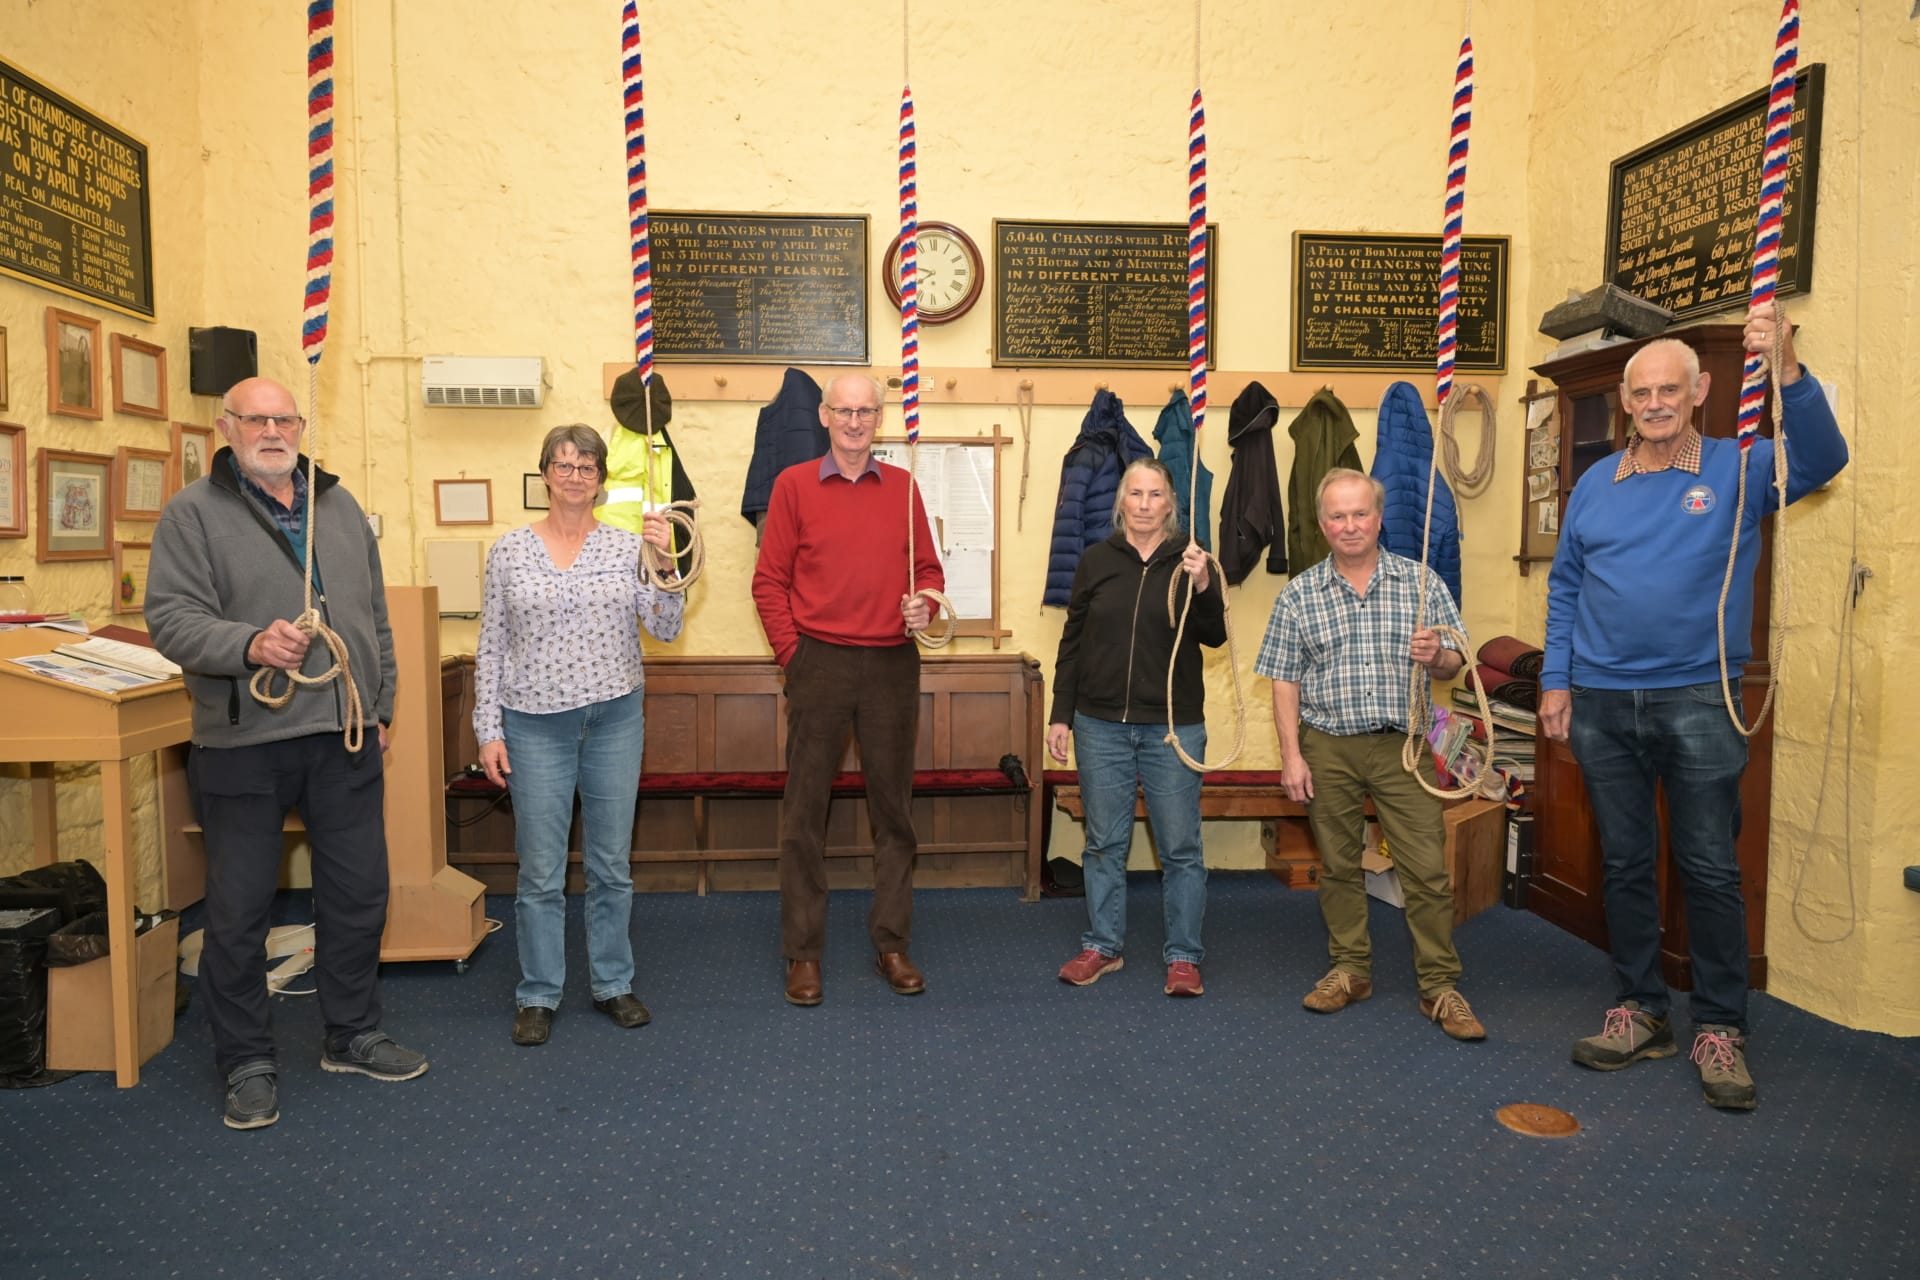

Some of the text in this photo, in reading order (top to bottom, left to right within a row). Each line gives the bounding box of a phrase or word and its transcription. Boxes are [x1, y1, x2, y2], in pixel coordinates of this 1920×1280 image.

[13, 86, 26, 108] OF
[30, 96, 87, 142] GRANDSIRE
[53, 129, 66, 149] OF
[100, 155, 141, 188] CHANGES
[1624, 172, 1636, 186] ON
[1640, 164, 1654, 179] THE
[1678, 144, 1695, 163] DAY
[1698, 138, 1710, 153] OF
[1714, 114, 1763, 147] FEBRUARY
[31, 136, 126, 200] RUNG IN 3 HOURS
[1623, 141, 1762, 208] TRIPLES WAS RUNG IN 3 HOURS
[1624, 134, 1747, 198] A PEAL OF CHANGES OF
[14, 152, 30, 176] ON
[48, 168, 79, 198] APRIL
[85, 184, 112, 212] 1999
[1622, 204, 1643, 220] MARK
[1648, 196, 1662, 210] THE
[1692, 155, 1758, 192] ANNIVERSARY
[3, 194, 23, 212] PLACE
[5, 173, 126, 238] PEAL ON AUGMENTED BELLS
[1621, 175, 1743, 231] CASTING OF THE BACK FIVE
[15, 212, 43, 232] WINTER
[1621, 226, 1642, 242] BELLS
[1646, 220, 1656, 233] BY
[1661, 203, 1701, 227] MEMBERS
[1706, 197, 1718, 210] OF
[1723, 188, 1741, 204] THE
[82, 228, 100, 243] JOHN
[697, 223, 766, 236] CHANGES
[770, 228, 804, 237] WERE
[811, 225, 854, 238] RUNG
[1052, 232, 1123, 244] CHANGES
[1125, 236, 1158, 245] WERE
[1162, 234, 1190, 246] RUN
[1620, 208, 1719, 253] SOCIETY & YORKSHIRE
[15, 238, 33, 254] DOVE
[654, 239, 670, 247] ON
[676, 239, 700, 247] THE
[732, 240, 756, 248] DAY
[762, 241, 776, 249] OF
[782, 242, 817, 250] APRIL
[1307, 246, 1316, 256] A
[1319, 246, 1347, 256] PEAL
[1387, 247, 1424, 258] MAJOR
[662, 251, 674, 259] IN
[690, 250, 732, 260] HOURS
[739, 252, 765, 261] AND
[1012, 258, 1024, 266] IN
[1038, 256, 1079, 267] HOURS
[1084, 260, 1110, 268] AND
[1112, 249, 1174, 258] NOVEMBER
[657, 264, 670, 273] IN
[676, 264, 683, 273] 7
[688, 264, 768, 274] DIFFERENT
[823, 267, 849, 276] VIZ.
[1351, 258, 1421, 270] CHANGES
[83, 264, 127, 288] DAVID TOWN
[83, 275, 114, 294] DOUGLAS
[1008, 270, 1189, 283] IN 7 DIFFERENT PEALS. VI
[1310, 271, 1325, 280] ON
[1331, 272, 1356, 280] THE
[1384, 272, 1405, 281] DAY
[1310, 282, 1323, 290] IN
[1328, 280, 1336, 290] 2
[1342, 281, 1380, 291] HOURS
[1386, 283, 1409, 292] AND
[1314, 293, 1487, 305] BY THE SIETY
[1313, 305, 1484, 317] OF CHANGE RINGER VIZ.
